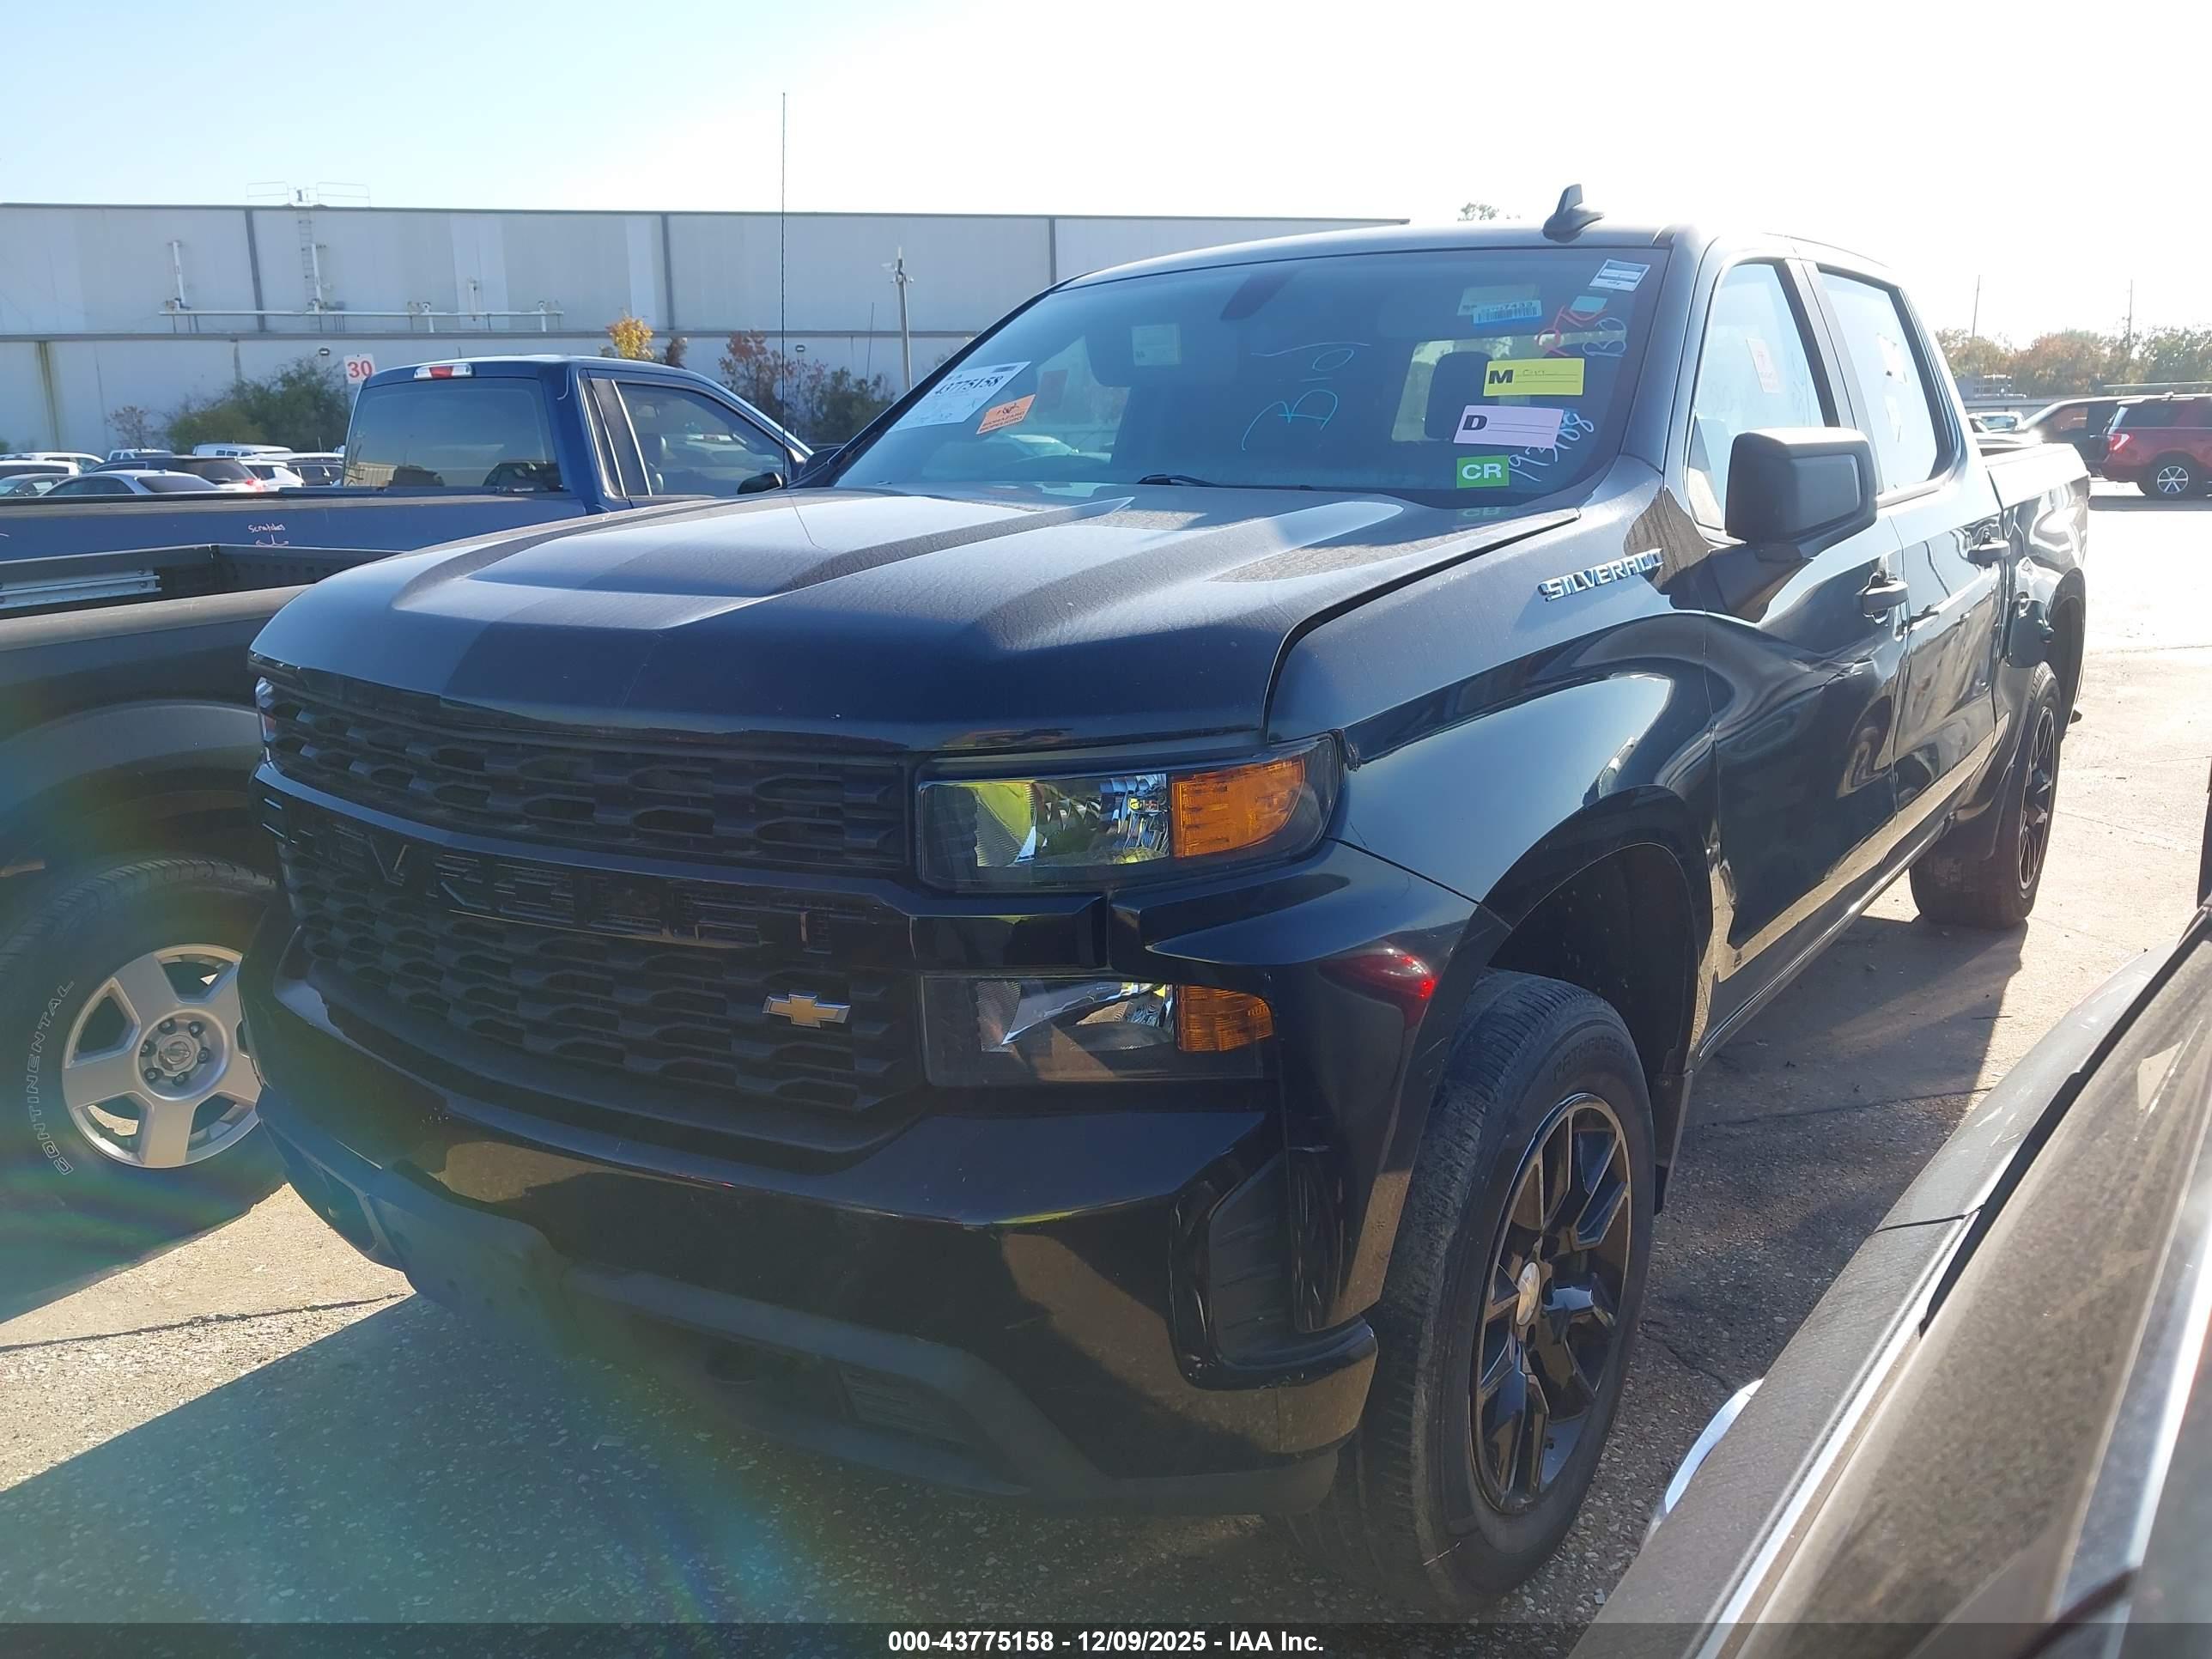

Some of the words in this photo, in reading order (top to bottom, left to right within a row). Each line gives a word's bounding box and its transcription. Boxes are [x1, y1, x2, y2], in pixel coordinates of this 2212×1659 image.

[347, 361, 373, 379] 30
[1488, 369, 1514, 385] M
[1462, 414, 1488, 432] D
[1462, 463, 1503, 479] CR
[1537, 548, 1664, 602] SILVERADO
[26, 979, 76, 1176] CONTINENTAL
